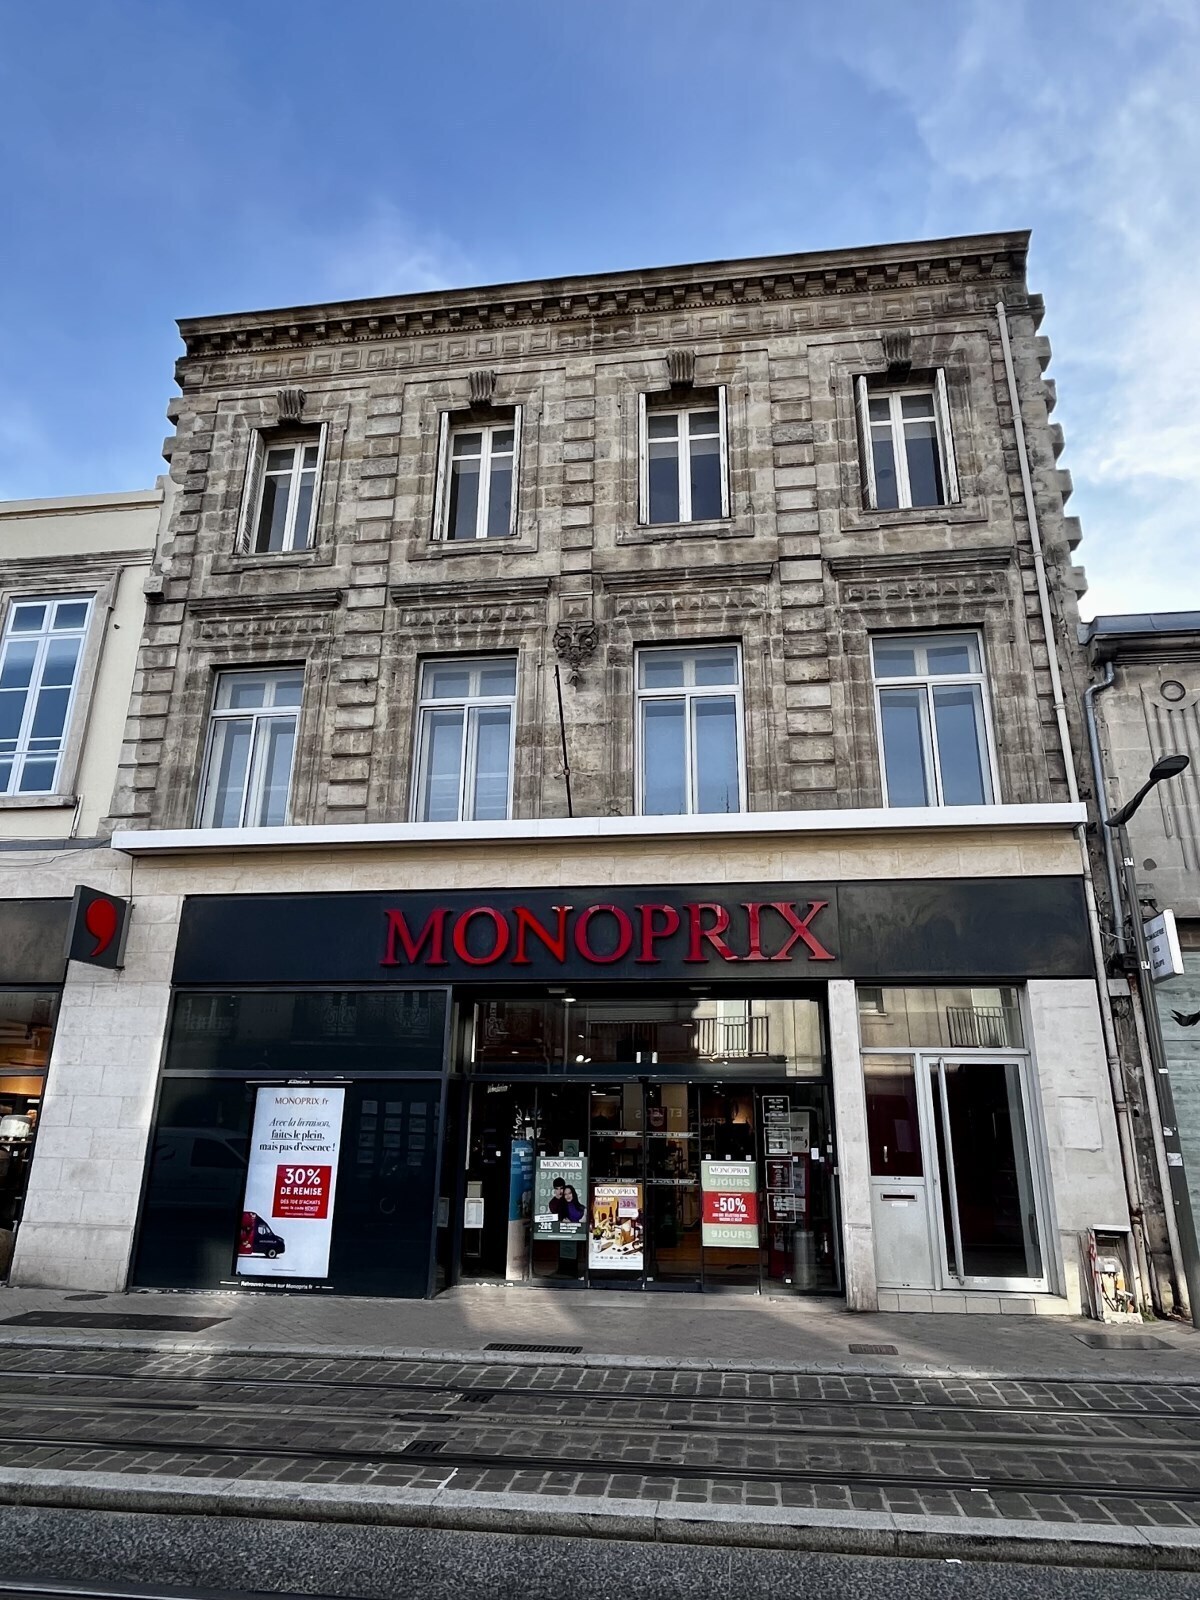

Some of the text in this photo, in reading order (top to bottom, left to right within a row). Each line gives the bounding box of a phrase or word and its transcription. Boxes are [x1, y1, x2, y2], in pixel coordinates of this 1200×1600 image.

[379, 902, 836, 966] MONOPRIX
[268, 1117, 331, 1128] Avec la livraison,
[271, 1129, 326, 1142] faites le plein,
[259, 1141, 279, 1152] mais
[279, 1144, 293, 1154] pas
[293, 1141, 331, 1153] d'essence
[542, 1160, 581, 1169] MONOPRIX
[710, 1166, 749, 1175] MONOPRIX
[284, 1168, 321, 1186] 30%
[280, 1187, 323, 1196] DE REMISE
[596, 1187, 638, 1196] MONOPRIX
